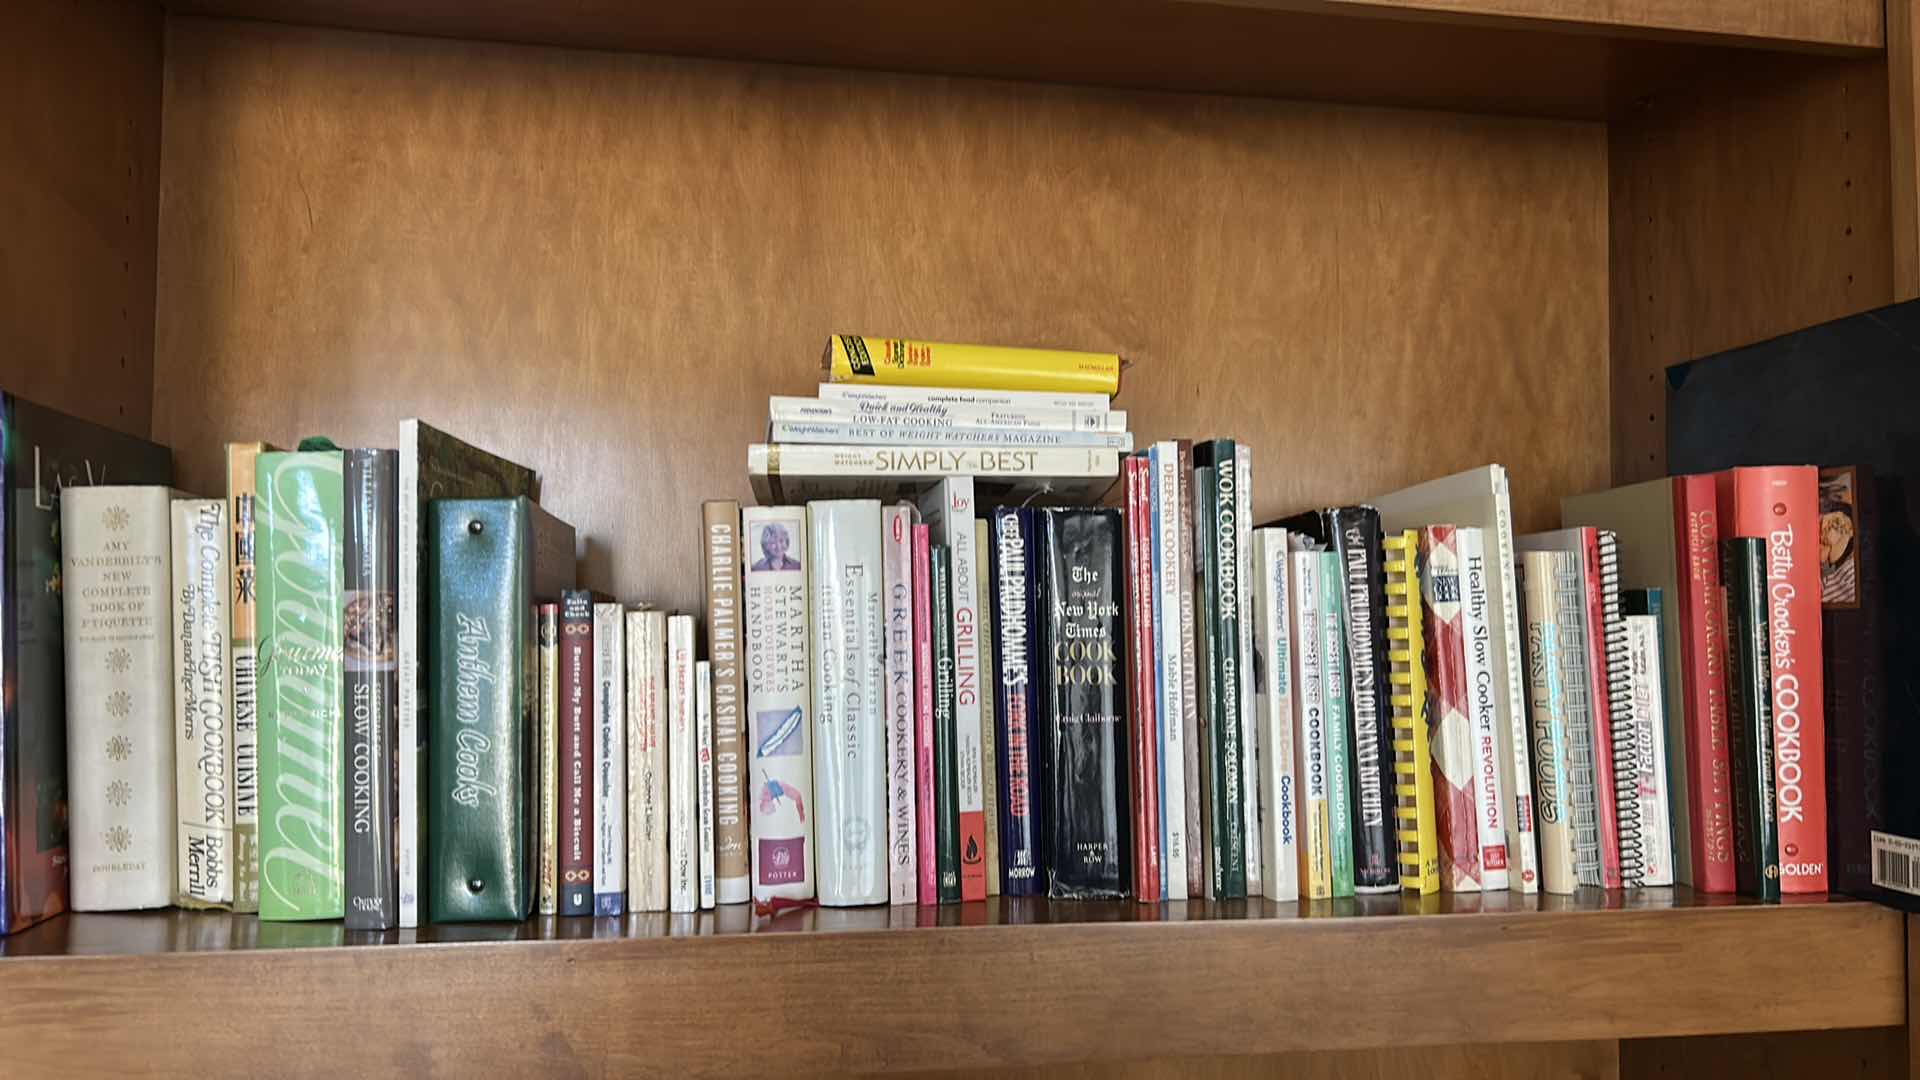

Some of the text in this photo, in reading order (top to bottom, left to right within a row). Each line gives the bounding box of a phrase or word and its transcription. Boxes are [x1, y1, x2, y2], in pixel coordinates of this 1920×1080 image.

[849, 428, 1061, 444] BEST OF WEIGHT WATCHERS MAGAZINE
[853, 415, 952, 427] LOW-FAT COOKING
[875, 451, 1038, 471] SIMPLY BEST
[952, 491, 970, 513] Joy
[103, 540, 129, 551] AMY
[103, 572, 132, 582] NEW
[1000, 538, 1025, 574] PAUL
[1072, 565, 1098, 585] The
[82, 586, 151, 598] COMPLETE
[90, 601, 145, 612] BOOK OF
[763, 585, 774, 621] HORS
[957, 532, 975, 705] ALL ABOUT GRILLING
[1054, 601, 1119, 620] New York
[1163, 463, 1179, 742] DEEP-FRY COOKERY Mable Hoffman
[1181, 591, 1194, 658] COOKING
[196, 503, 224, 825] The Complete FISH COOKBOOK
[750, 587, 765, 694] HANDBOOK
[775, 585, 790, 693] STEWART'S
[789, 585, 805, 691] MARTHA
[843, 563, 863, 760] Essentials of Classic
[867, 591, 880, 716] Marcella Hazan
[1001, 575, 1029, 685] PRUDHOMME'S
[1055, 641, 1117, 662] COOK
[1065, 622, 1107, 639] Times
[1219, 459, 1239, 803] WOK COOKBOOK CHARMAINE SOLOMON
[1499, 509, 1511, 582] COOKING
[1505, 591, 1514, 632] WITH
[1513, 715, 1524, 766] CHEFS
[235, 655, 257, 732] CHINESE
[452, 613, 497, 808] Anthem Cooks
[602, 680, 611, 724] Complete
[711, 522, 739, 826] CHARLIE PALMER'S CASUAL COOKING
[820, 648, 836, 724] Cooking
[936, 656, 953, 720] Grilling
[1055, 665, 1117, 686] BOOK
[1347, 548, 1383, 827] PAUL PRUDHOMME'S LOUISIANA KITCHEN
[1468, 556, 1498, 829] Healthy Slow Cooker REVOLUTION
[1700, 511, 1729, 863] CONTEMPORARY TABLE SETTINGS
[1767, 524, 1804, 823] Betty Crocker's COOKBOOK
[353, 683, 370, 834] SLOW COOKING
[572, 646, 583, 861] Butter My Butt and Call Me a Biscuit
[602, 727, 611, 759] Calorie
[892, 583, 910, 865] GREEK COOKERY & WINES
[1277, 638, 1293, 845] Ultimate Cookbook
[1308, 707, 1323, 796] COOKBOOK
[1332, 705, 1342, 751] FAMILY
[1530, 623, 1561, 824] PARTY FOODS
[1635, 720, 1656, 799] T-Factor
[237, 744, 257, 817] CUISINE
[602, 761, 611, 798] Counter
[1333, 755, 1346, 831] COOKBOOK
[188, 835, 205, 896] Merrill
[206, 834, 223, 888] Bobbs
[1009, 867, 1035, 879] MORROW
[1084, 856, 1102, 864] ROW
[1779, 863, 1824, 876] GOLDEN
